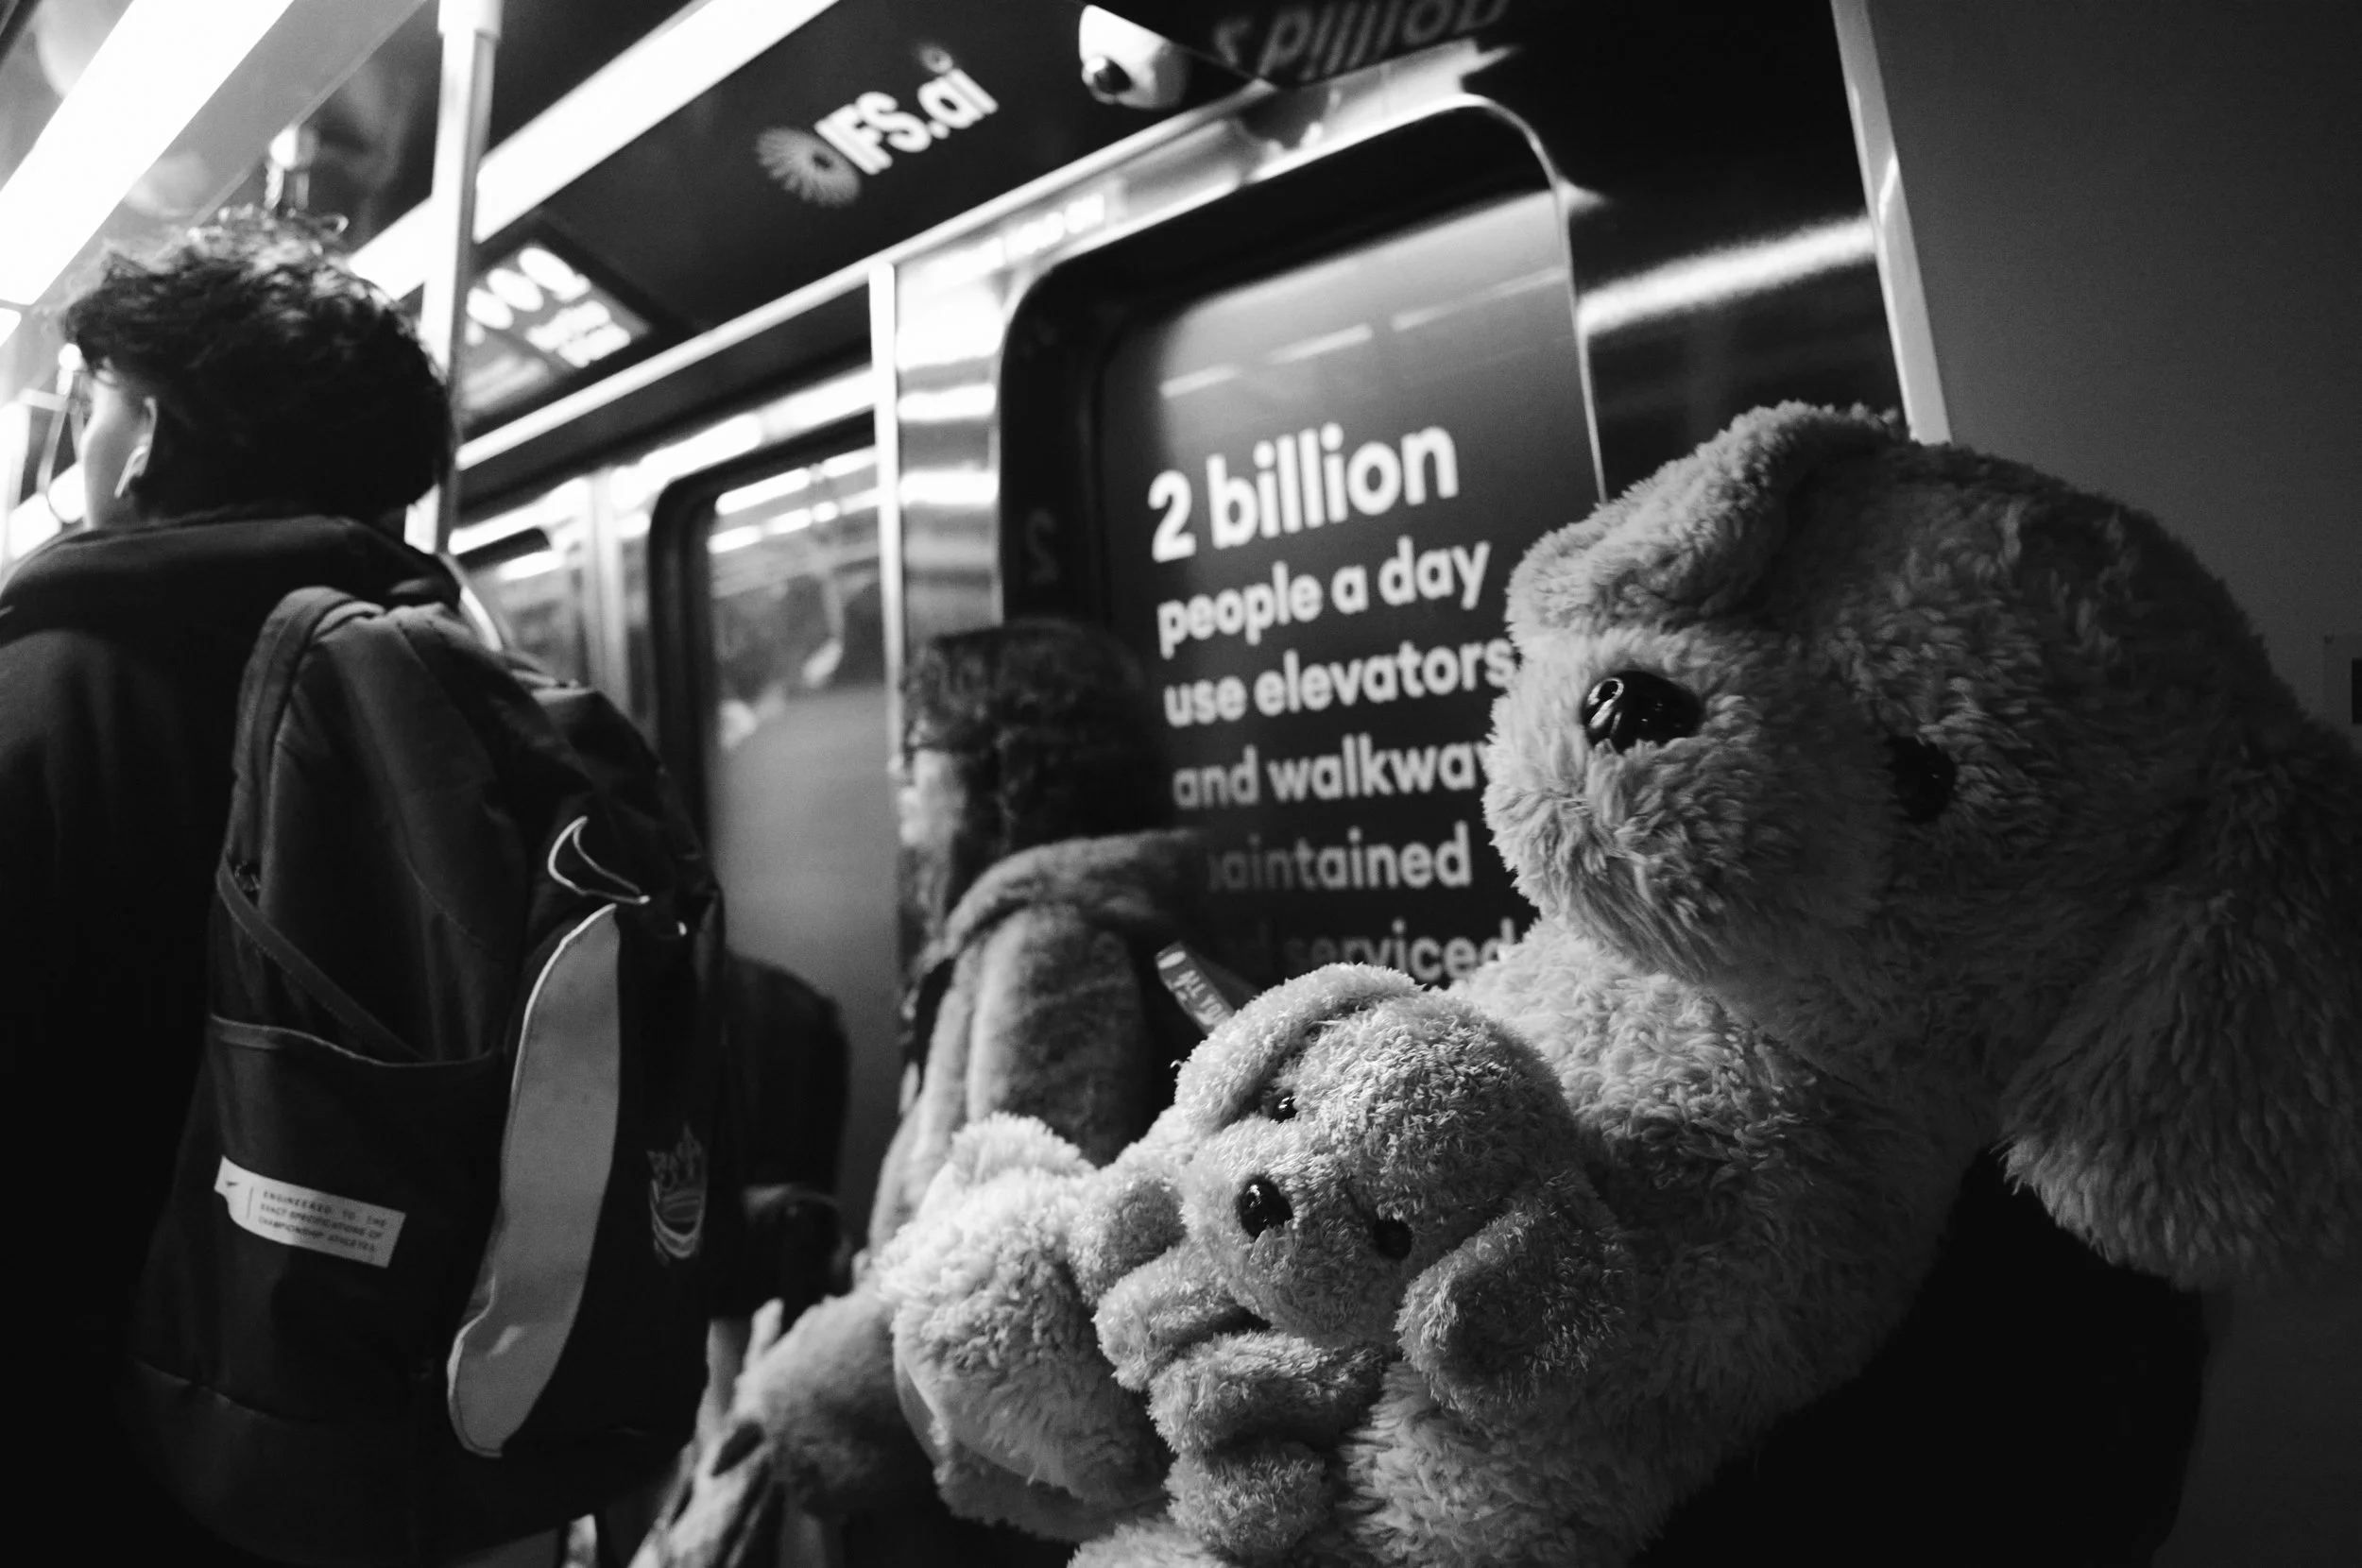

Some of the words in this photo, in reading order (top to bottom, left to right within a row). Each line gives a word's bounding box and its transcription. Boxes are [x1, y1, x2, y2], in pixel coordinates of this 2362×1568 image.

[813, 45, 999, 176] IFS.ai
[1148, 469, 1196, 563] 2
[1206, 422, 1460, 550] billion
[1157, 560, 1323, 660] people
[1331, 565, 1369, 615] a
[1378, 535, 1491, 610] day
[1164, 674, 1247, 727] use
[1254, 639, 1515, 717] elevators
[1173, 744, 1259, 810] and
[1267, 732, 1492, 802] walkwa
